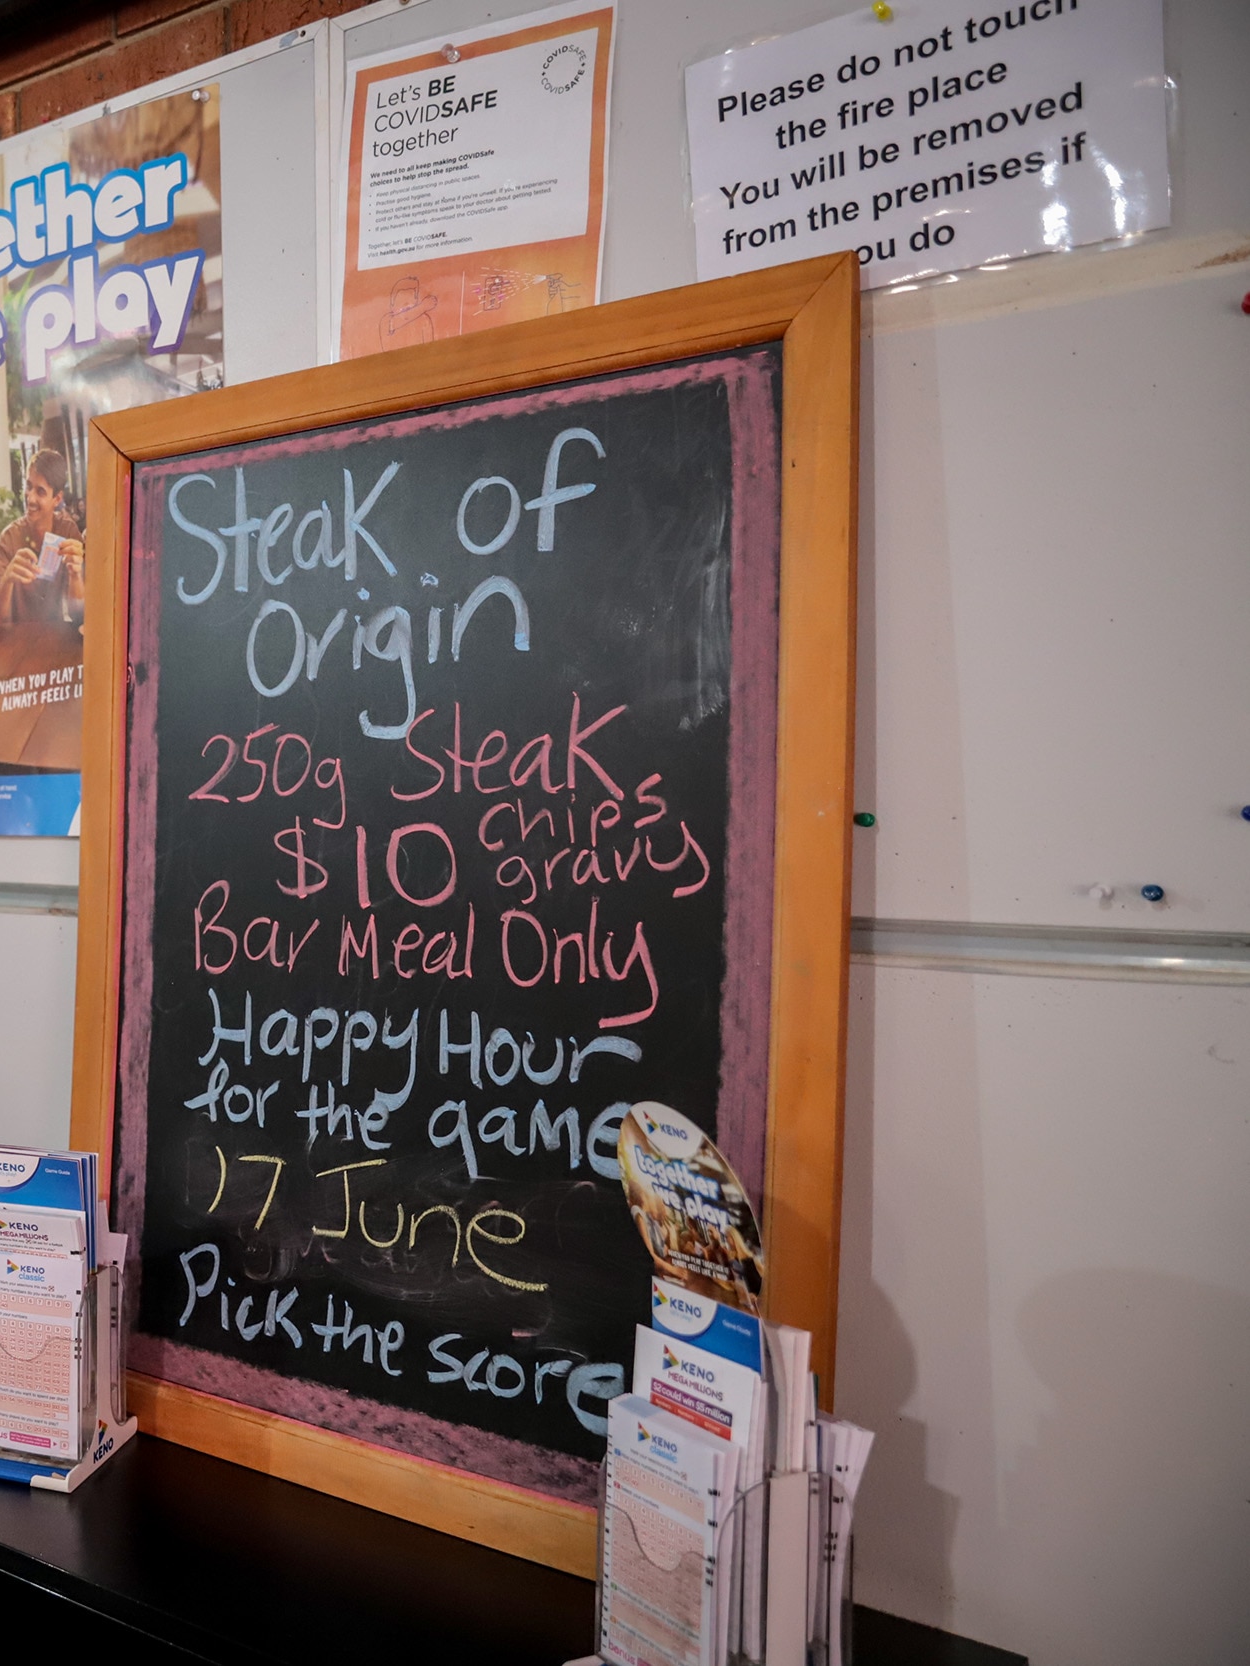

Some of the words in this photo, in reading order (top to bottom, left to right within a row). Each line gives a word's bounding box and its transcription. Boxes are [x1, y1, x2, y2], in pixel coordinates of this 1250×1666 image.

[376, 85, 421, 109] Let's
[428, 75, 456, 97] BE
[717, 72, 825, 122] Please
[837, 54, 880, 85] do
[893, 26, 953, 68] not
[374, 89, 499, 132] COVIDSAFE
[775, 115, 826, 149] the
[837, 93, 894, 130] fire
[907, 61, 1008, 116] place
[372, 125, 459, 158] together
[382, 168, 397, 177] need
[406, 165, 415, 173] all
[415, 161, 432, 171] keep
[432, 157, 457, 167] making
[458, 149, 495, 162] COVIDSafe
[720, 178, 780, 210] You
[790, 152, 845, 190] will
[858, 138, 899, 170] be
[913, 82, 1084, 155] removed
[369, 178, 393, 188] choices
[402, 173, 416, 182] help
[417, 170, 432, 180] stop
[432, 167, 444, 175] the
[723, 218, 797, 255] from
[807, 197, 859, 231] the
[872, 147, 1045, 221] premises
[1060, 132, 1087, 165] if
[856, 238, 896, 265] ou
[909, 222, 955, 252] do
[21, 250, 205, 387] play
[168, 460, 403, 604] Steak
[457, 427, 607, 555] of
[29, 672, 46, 689] YOU
[50, 667, 75, 686] PLAY
[246, 574, 530, 739] Origin
[2, 691, 38, 712] ALWAYS
[40, 685, 70, 704] FEELS
[188, 723, 347, 829] 250g
[391, 690, 629, 801] Steak
[478, 773, 668, 850] chips
[274, 815, 457, 908] $10
[495, 821, 711, 904] gravy
[194, 880, 319, 976] Bar
[338, 902, 474, 979] Meal
[500, 897, 659, 1029] Only
[198, 988, 419, 1112] Happy
[440, 1007, 642, 1090] Hour
[184, 1059, 281, 1128] for
[295, 1080, 392, 1151] the
[428, 1098, 632, 1180] game
[659, 1123, 688, 1141] KENO
[634, 1145, 719, 1201] together
[8, 1222, 39, 1232] KENO
[209, 1146, 287, 1231] 17
[313, 1159, 549, 1291] June
[652, 1183, 682, 1210] we
[684, 1194, 730, 1234] play
[18, 1273, 45, 1282] classic
[20, 1265, 45, 1274] KENO
[669, 1297, 702, 1319] KENO
[179, 1243, 303, 1348] Pick
[311, 1293, 405, 1376] the
[427, 1333, 625, 1437] score
[681, 1360, 715, 1383] KENO
[662, 1386, 682, 1400] could
[682, 1396, 695, 1407] win
[705, 1404, 731, 1424] million
[93, 1437, 114, 1464] KENO
[651, 1434, 678, 1453] KENO
[608, 1639, 637, 1665] bonus
